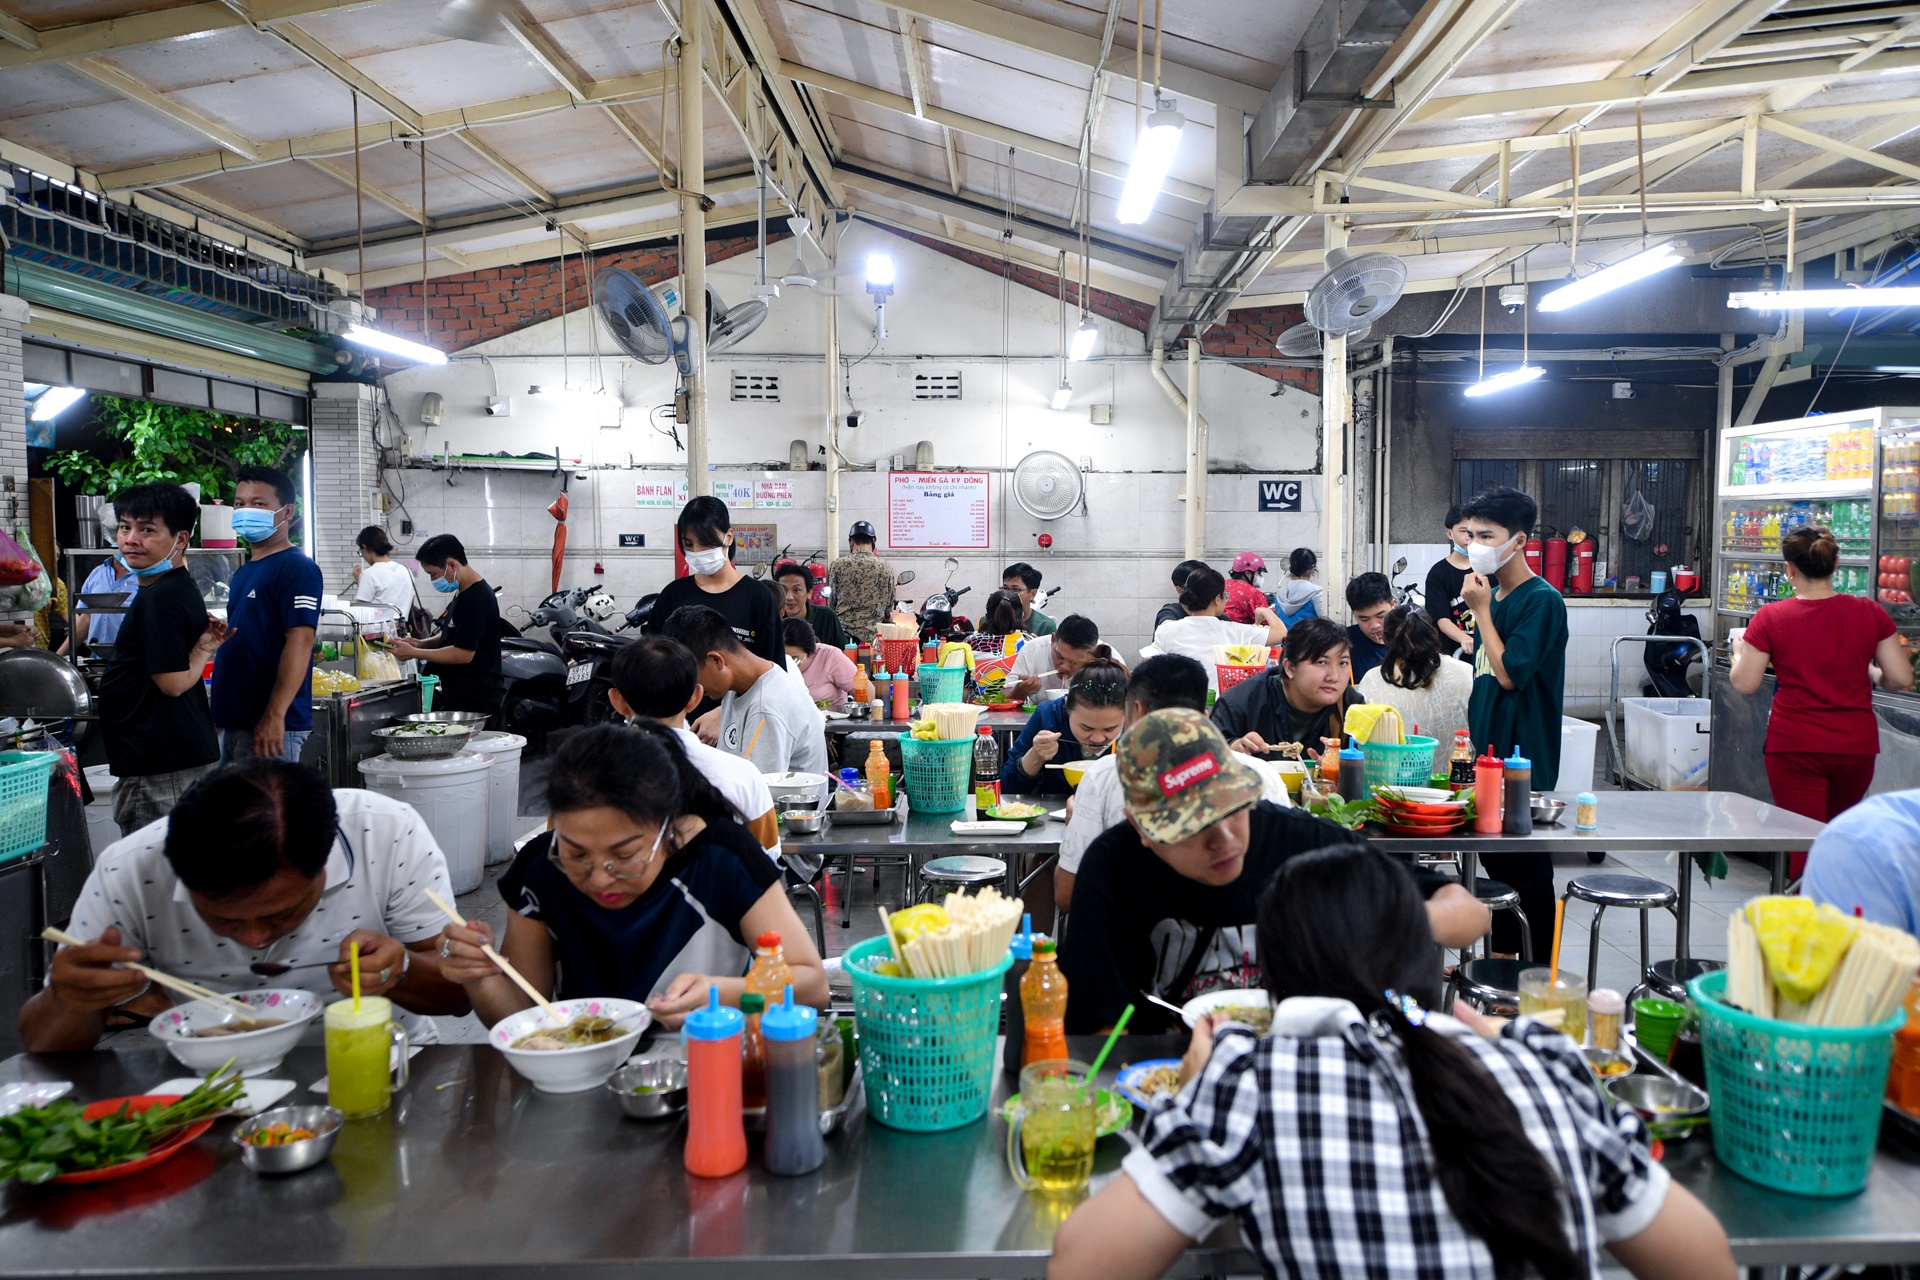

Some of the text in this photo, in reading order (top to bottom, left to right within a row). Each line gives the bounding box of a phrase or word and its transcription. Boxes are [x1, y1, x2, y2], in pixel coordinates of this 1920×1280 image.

[637, 482, 672, 495] BÁNH FLAN
[733, 488, 750, 498] 40K
[1262, 482, 1298, 501] WC
[1164, 758, 1213, 789] Supreme
